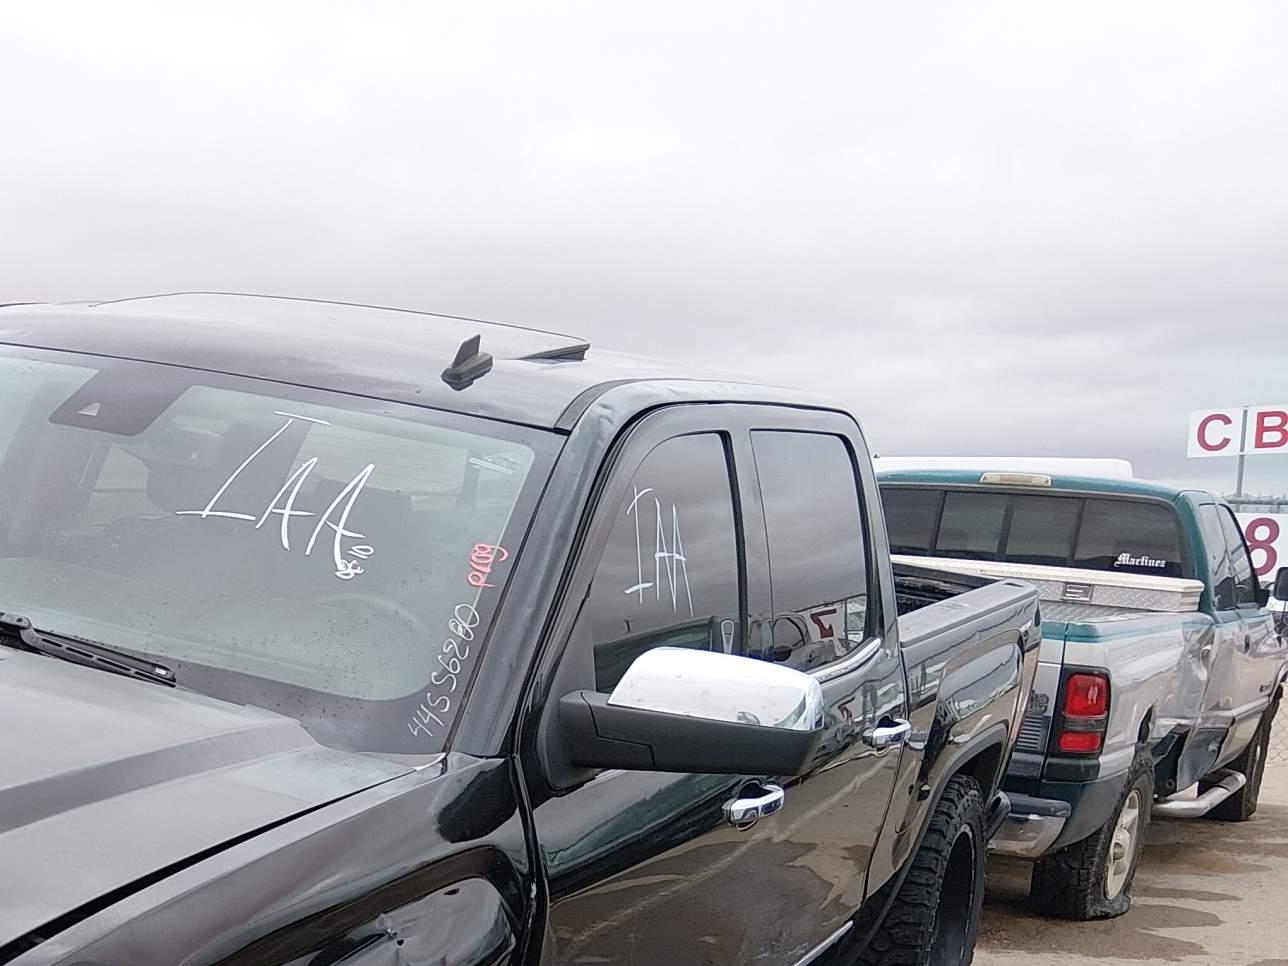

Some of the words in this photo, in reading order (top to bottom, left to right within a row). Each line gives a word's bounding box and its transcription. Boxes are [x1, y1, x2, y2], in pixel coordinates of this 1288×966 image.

[1197, 414, 1232, 451] C
[1254, 411, 1288, 449] B
[176, 411, 374, 571] IAA
[624, 486, 694, 617] IAA
[1114, 553, 1167, 568] Martinez
[1245, 517, 1280, 577] 8
